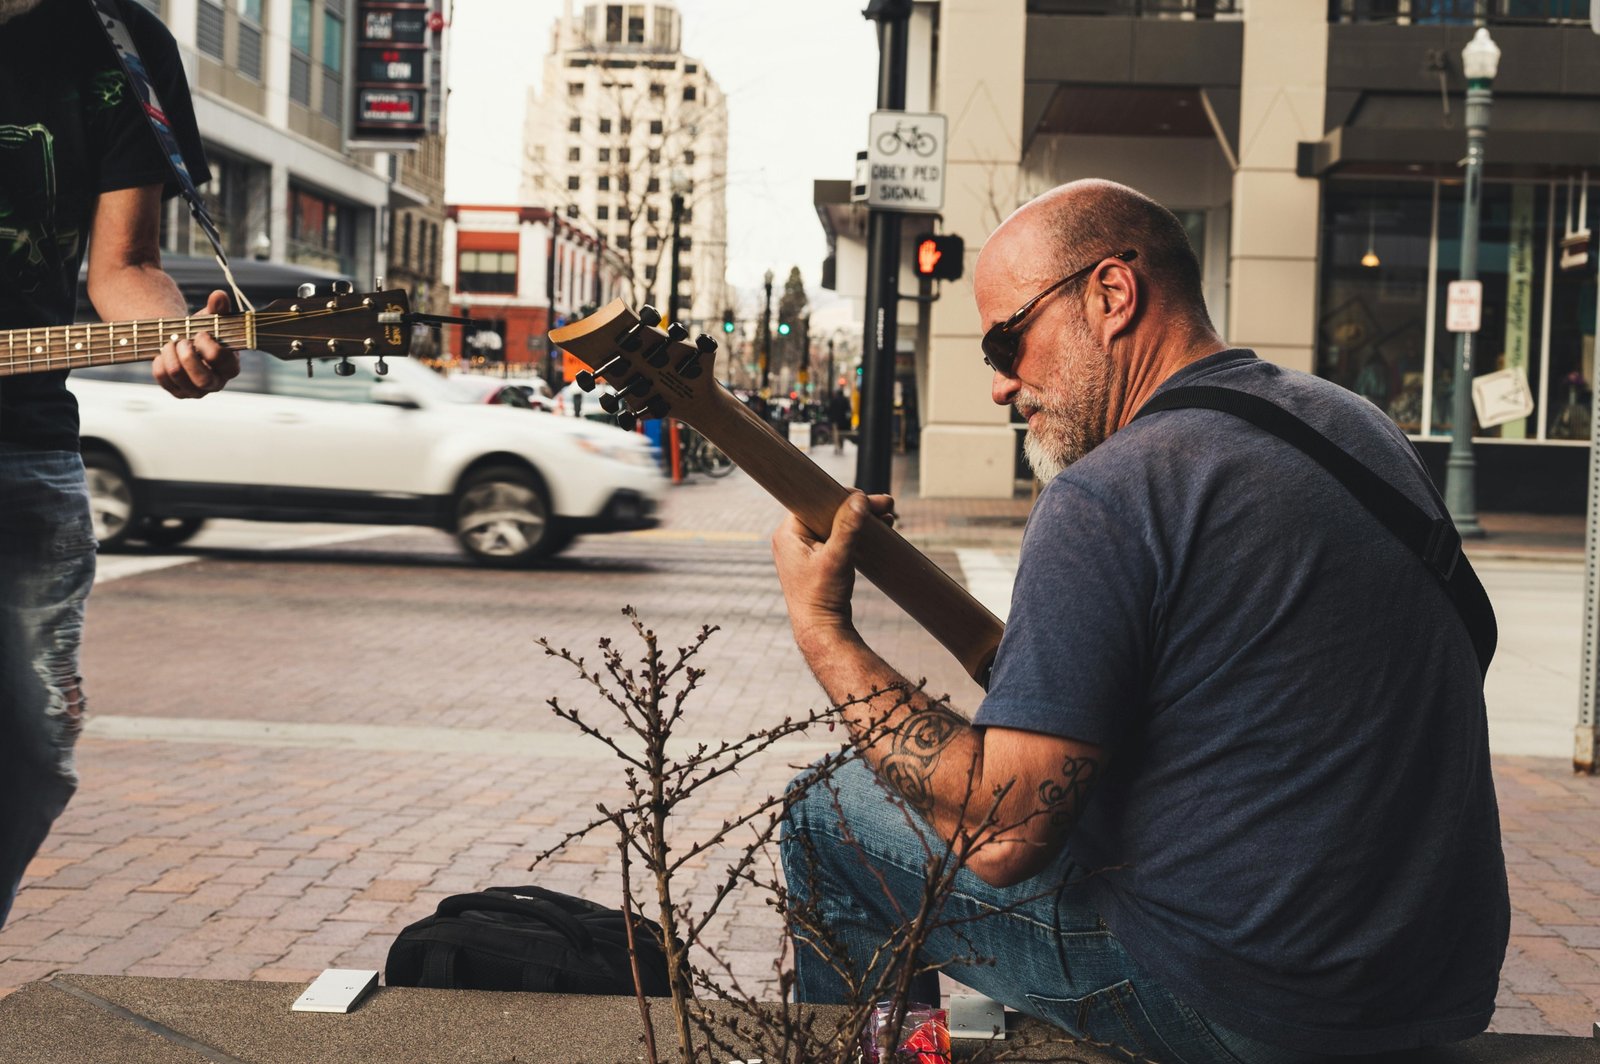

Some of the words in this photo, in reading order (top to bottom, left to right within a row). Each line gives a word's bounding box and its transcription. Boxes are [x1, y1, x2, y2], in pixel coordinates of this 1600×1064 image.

[872, 164, 906, 180] OBEY
[912, 165, 940, 181] PED
[880, 184, 927, 201] SIGNAL
